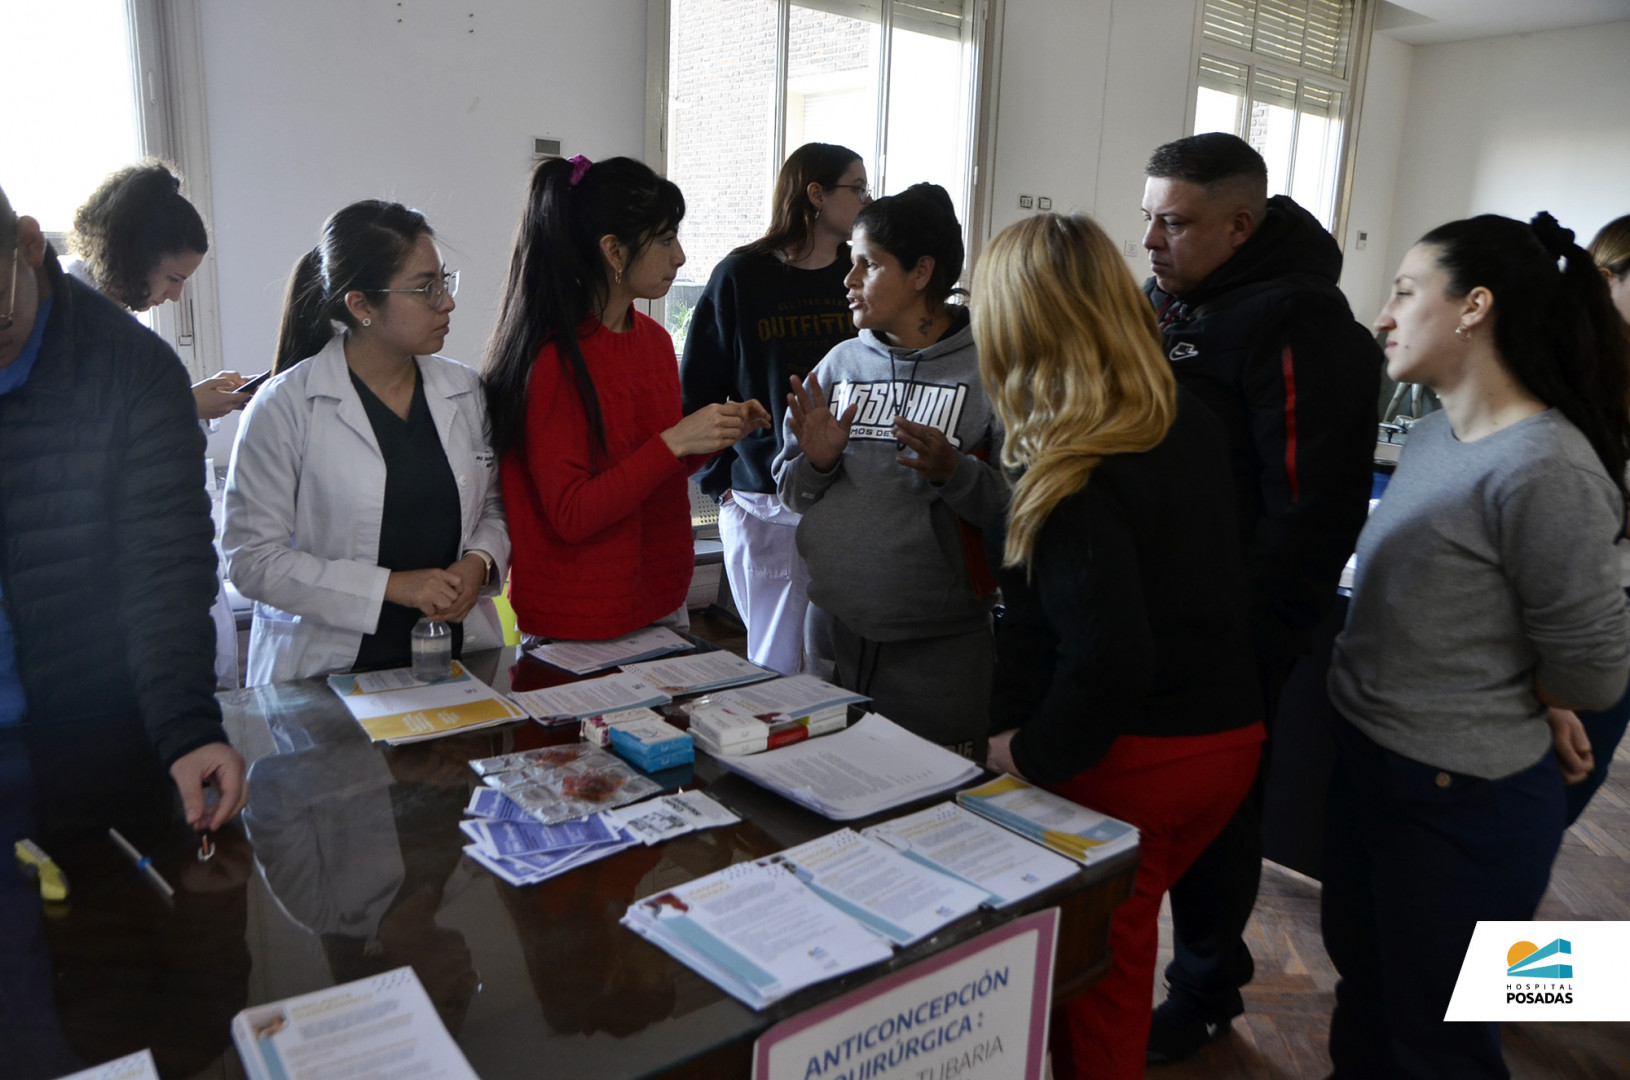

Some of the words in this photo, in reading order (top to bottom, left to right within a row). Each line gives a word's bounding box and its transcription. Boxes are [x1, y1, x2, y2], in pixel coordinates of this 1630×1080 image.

[850, 427, 874, 437] MOS
[804, 966, 1010, 1080] ANTICONCEPCIÓN
[834, 1011, 984, 1080] UIRÚRGICA:
